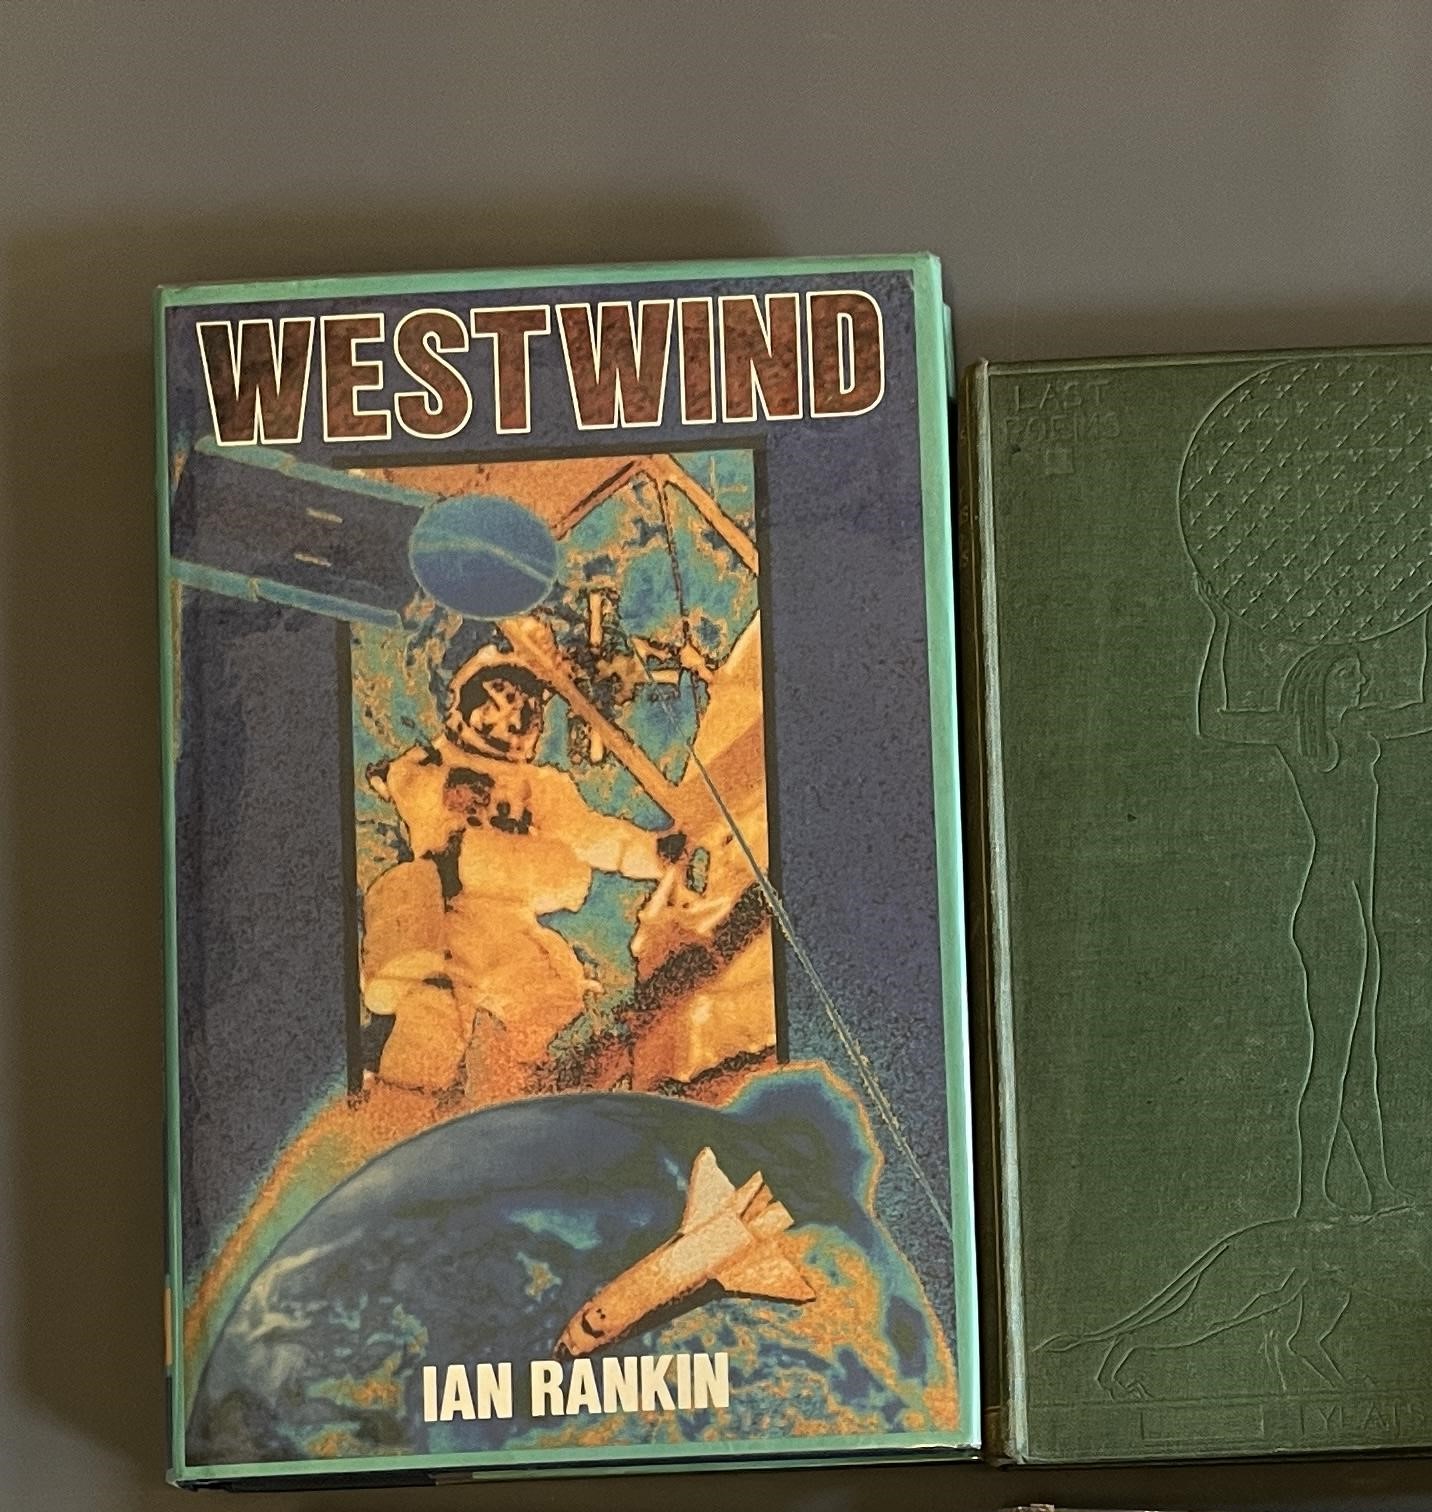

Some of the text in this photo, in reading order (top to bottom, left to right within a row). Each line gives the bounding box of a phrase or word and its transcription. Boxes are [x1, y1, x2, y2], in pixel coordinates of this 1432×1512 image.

[196, 289, 886, 446] WESTWIND
[423, 1352, 729, 1422] IAN RANKIN
